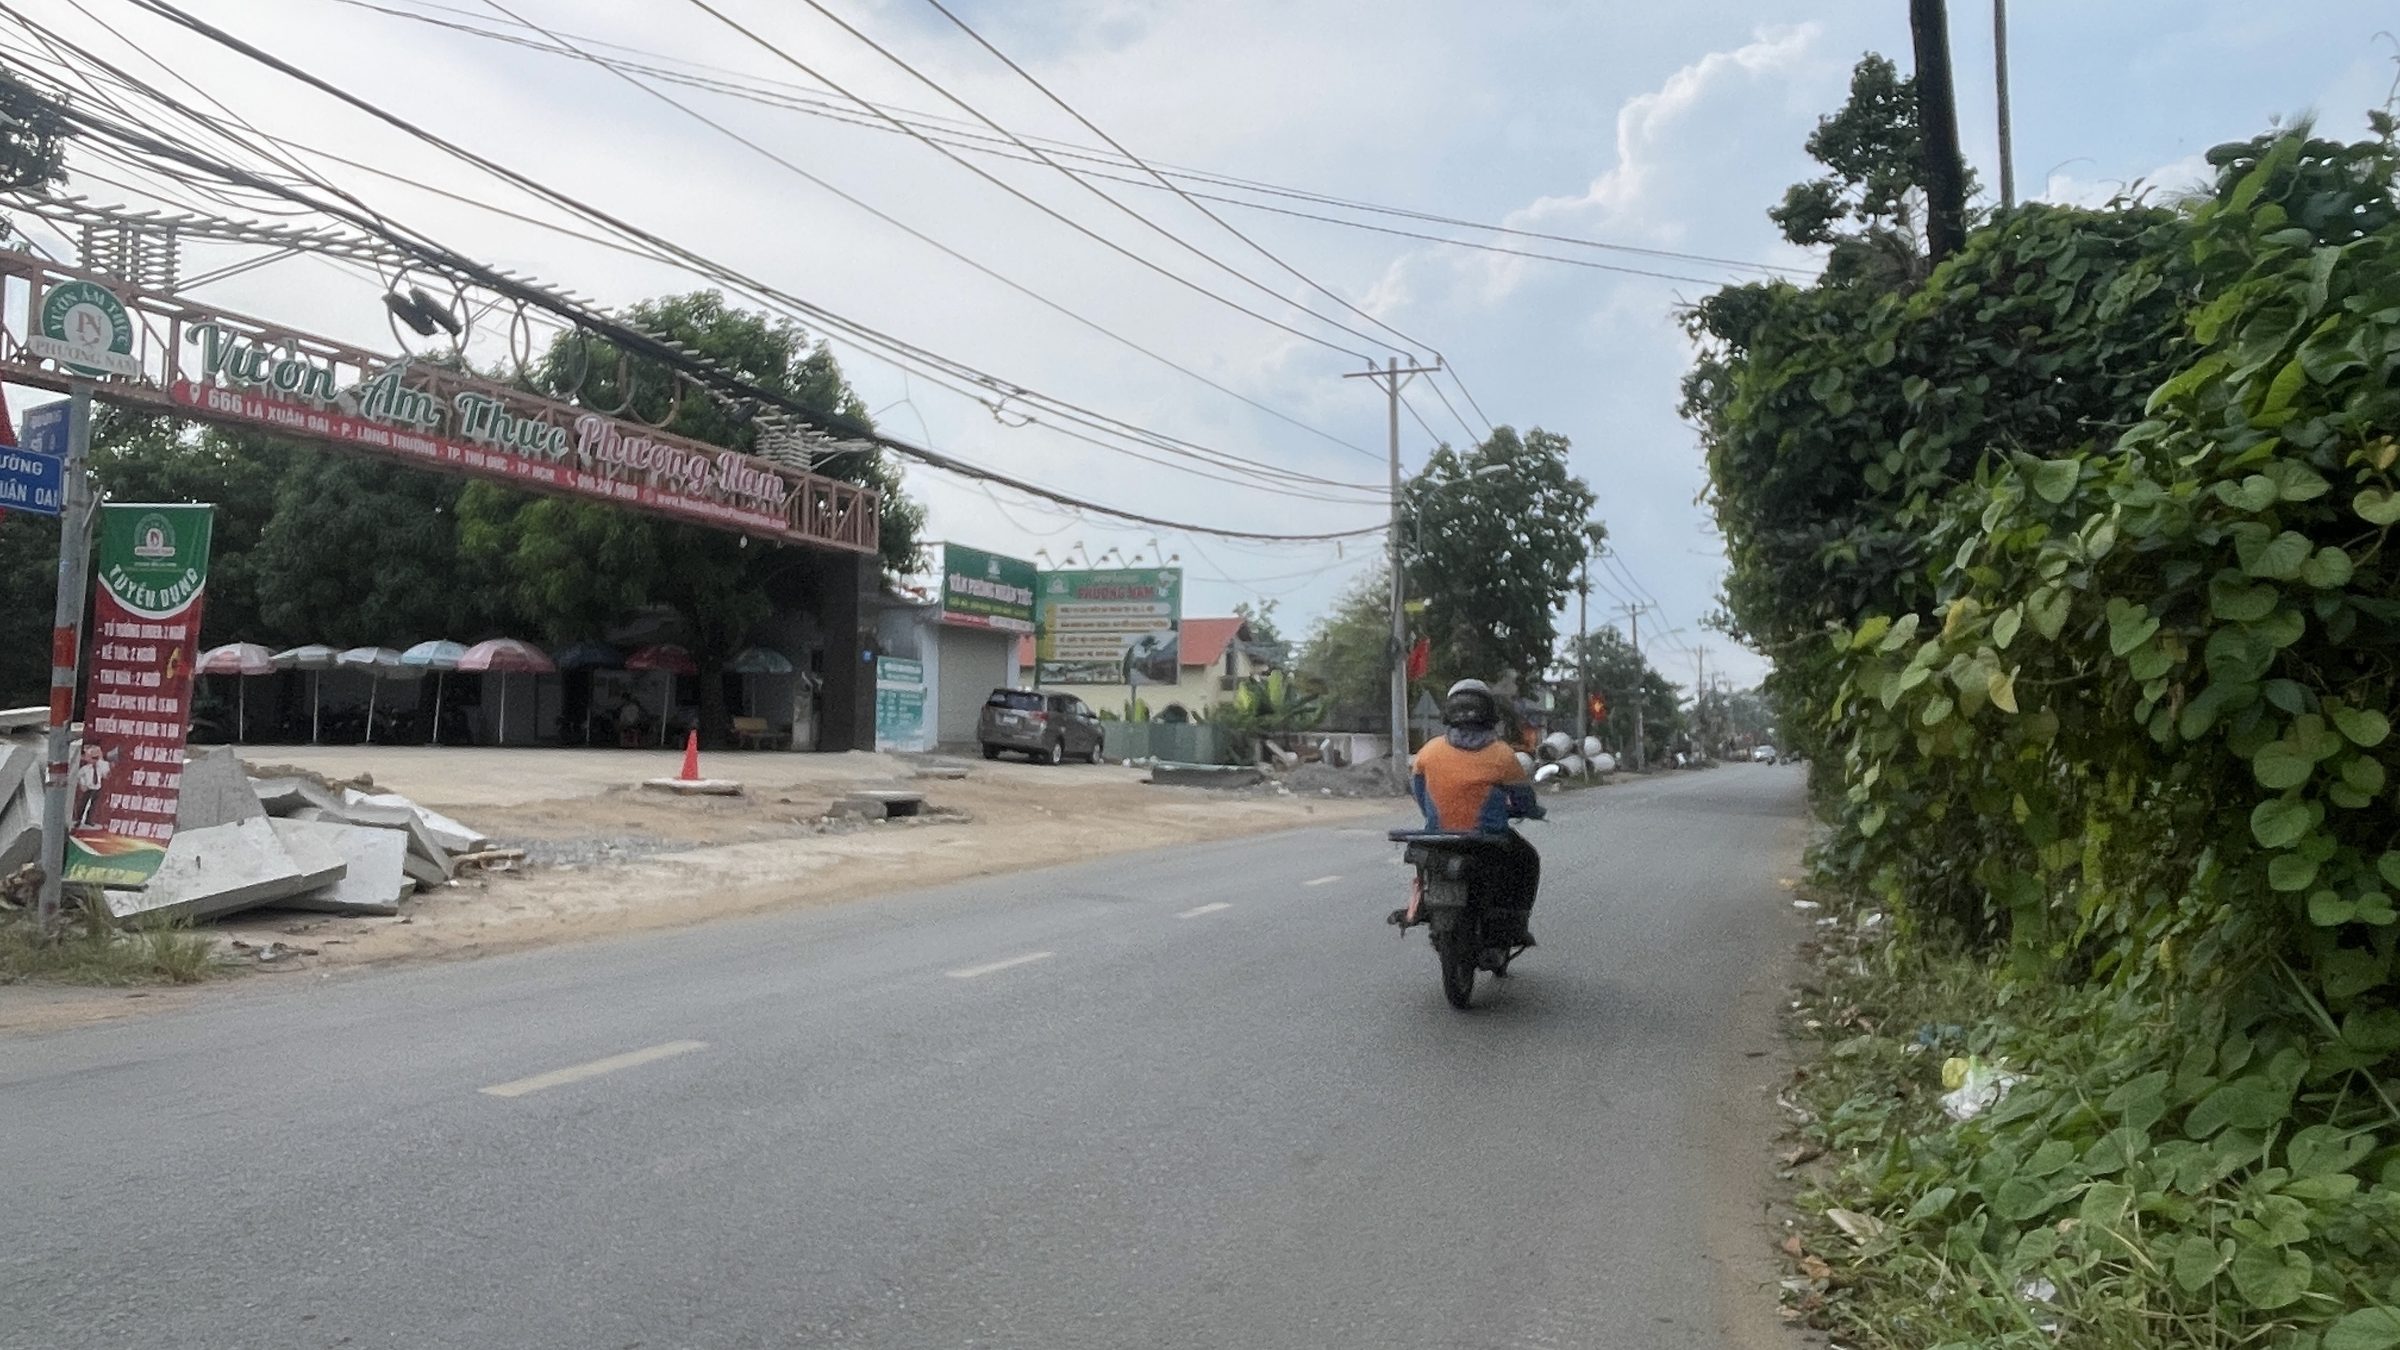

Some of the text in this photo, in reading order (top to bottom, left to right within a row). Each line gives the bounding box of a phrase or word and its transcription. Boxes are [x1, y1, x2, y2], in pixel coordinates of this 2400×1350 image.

[185, 321, 339, 403] Vườn
[574, 414, 710, 496] Phương
[716, 450, 786, 503] Nam
